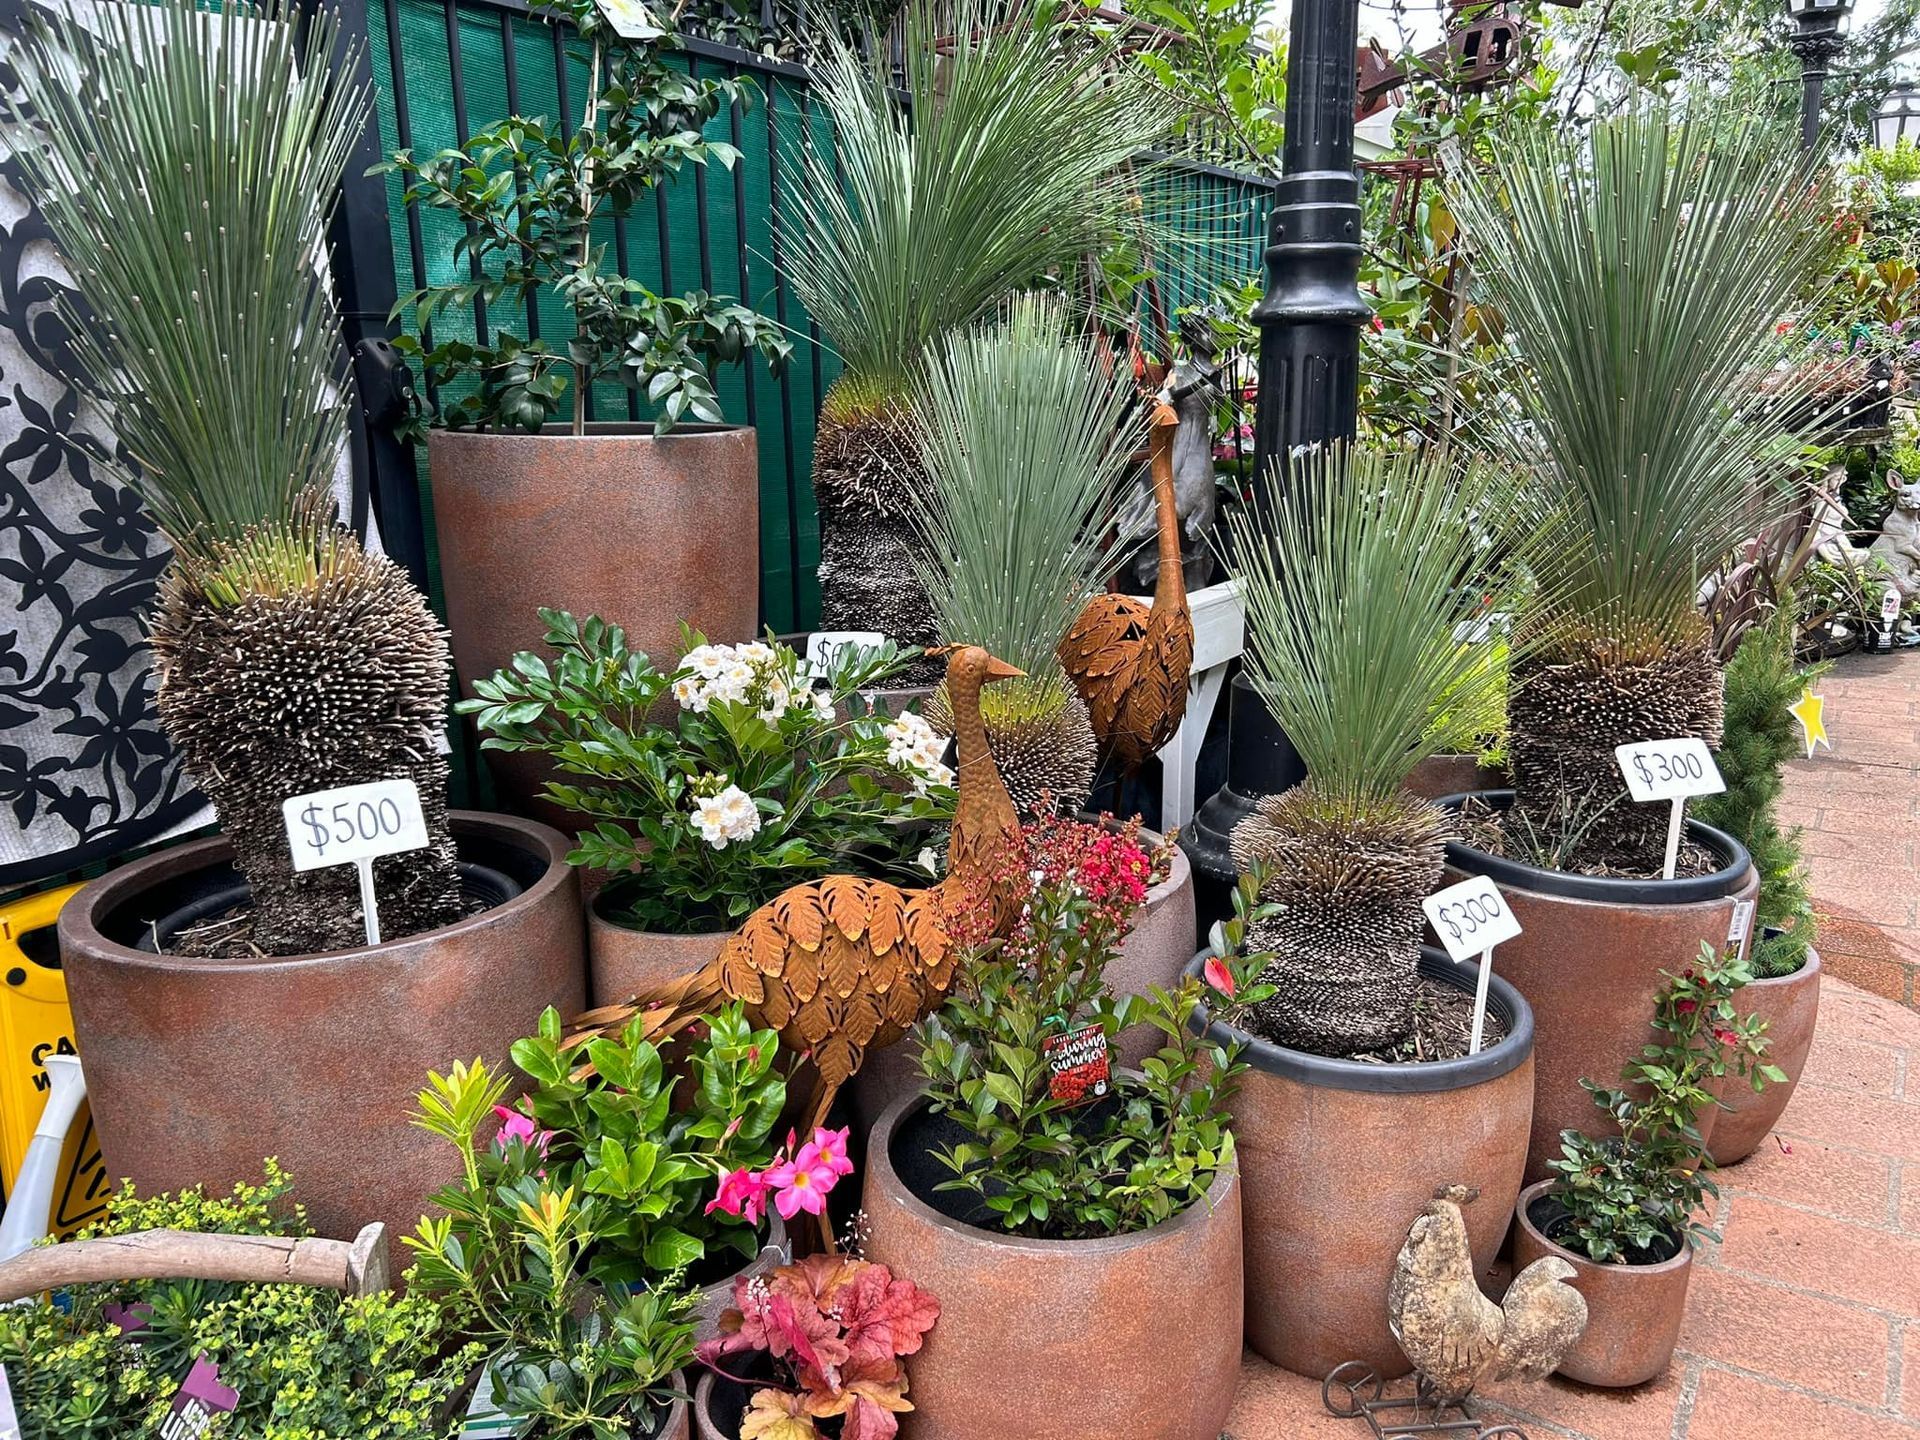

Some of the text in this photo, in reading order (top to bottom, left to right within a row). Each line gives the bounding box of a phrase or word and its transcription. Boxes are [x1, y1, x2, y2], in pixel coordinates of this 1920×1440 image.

[816, 637, 870, 674] $60
[1633, 751, 1703, 792] $300
[301, 797, 401, 856] $500
[1438, 893, 1500, 946] $300
[1044, 1031, 1107, 1061] eduring
[1050, 1047, 1104, 1077] summer
